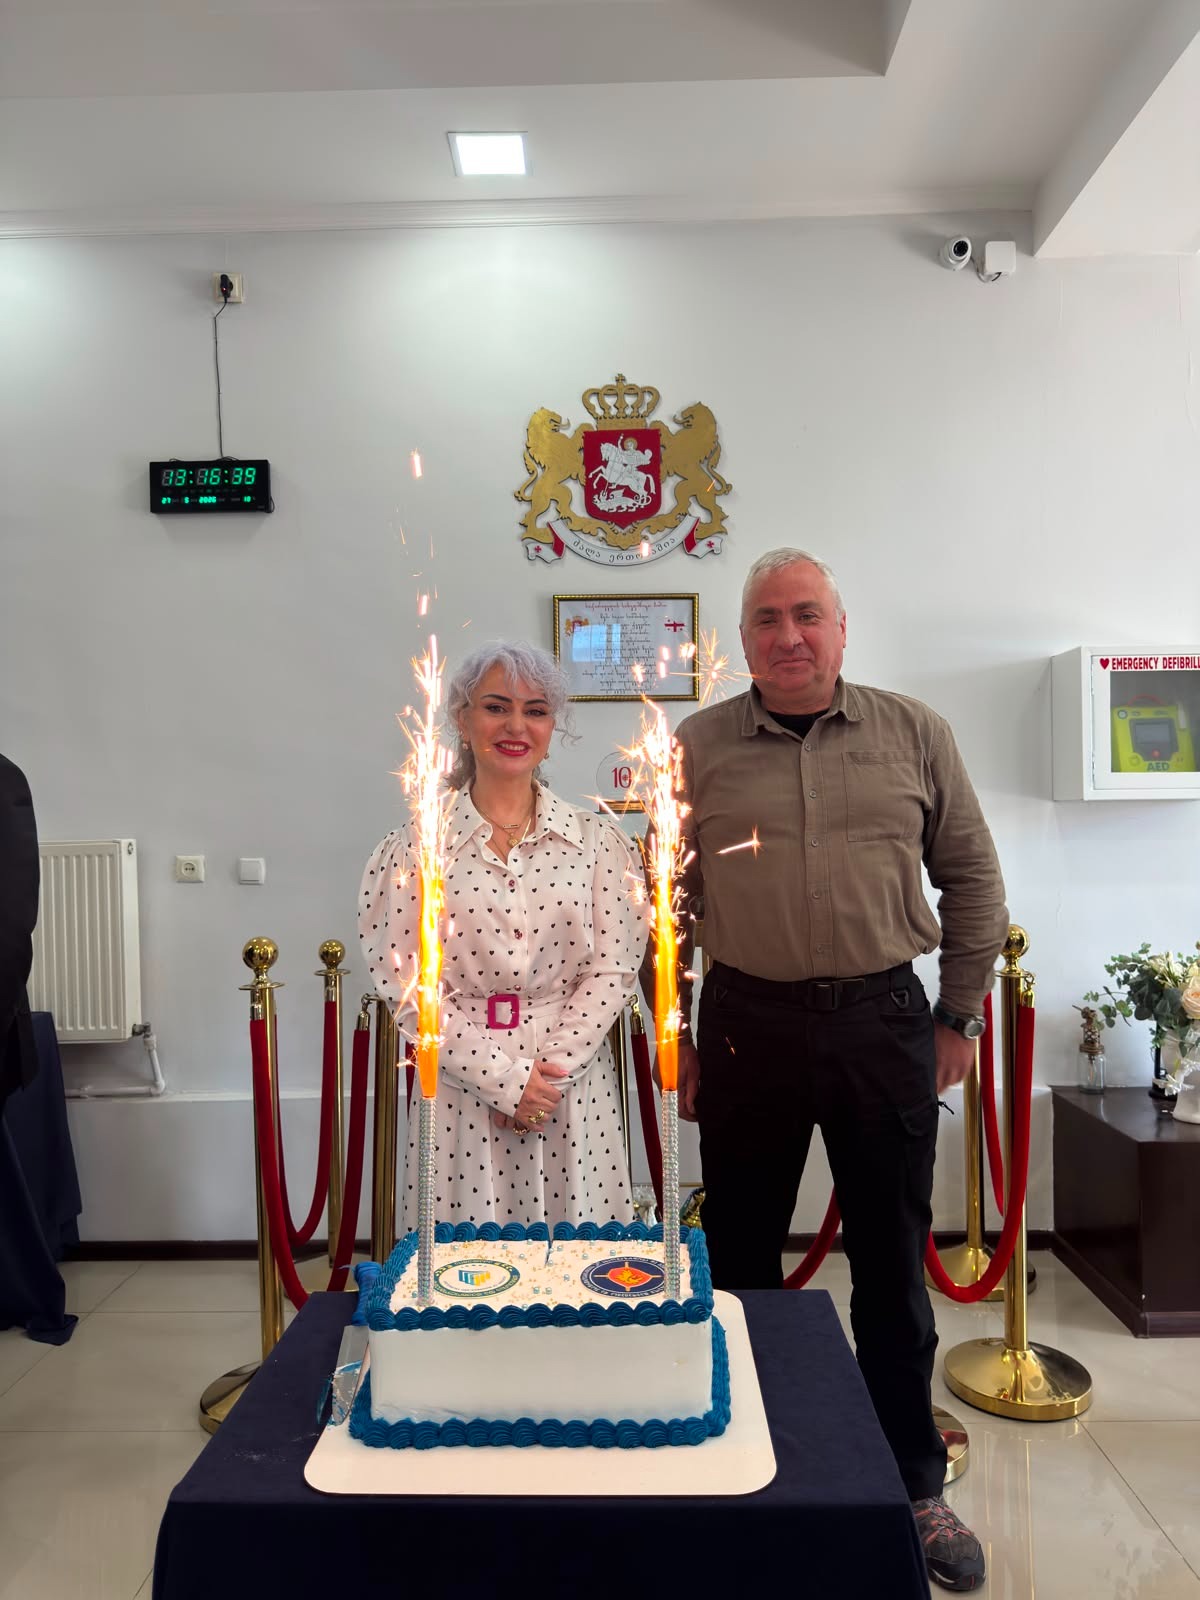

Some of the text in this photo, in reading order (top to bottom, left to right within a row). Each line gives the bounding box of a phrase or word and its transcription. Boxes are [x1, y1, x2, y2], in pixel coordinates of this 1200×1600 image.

[163, 467, 256, 486] 13:16:39
[572, 536, 676, 563] ძალა ერთოაშია
[1111, 657, 1159, 670] EMERGENCY
[1147, 762, 1170, 772] AED
[611, 766, 632, 788] 10
